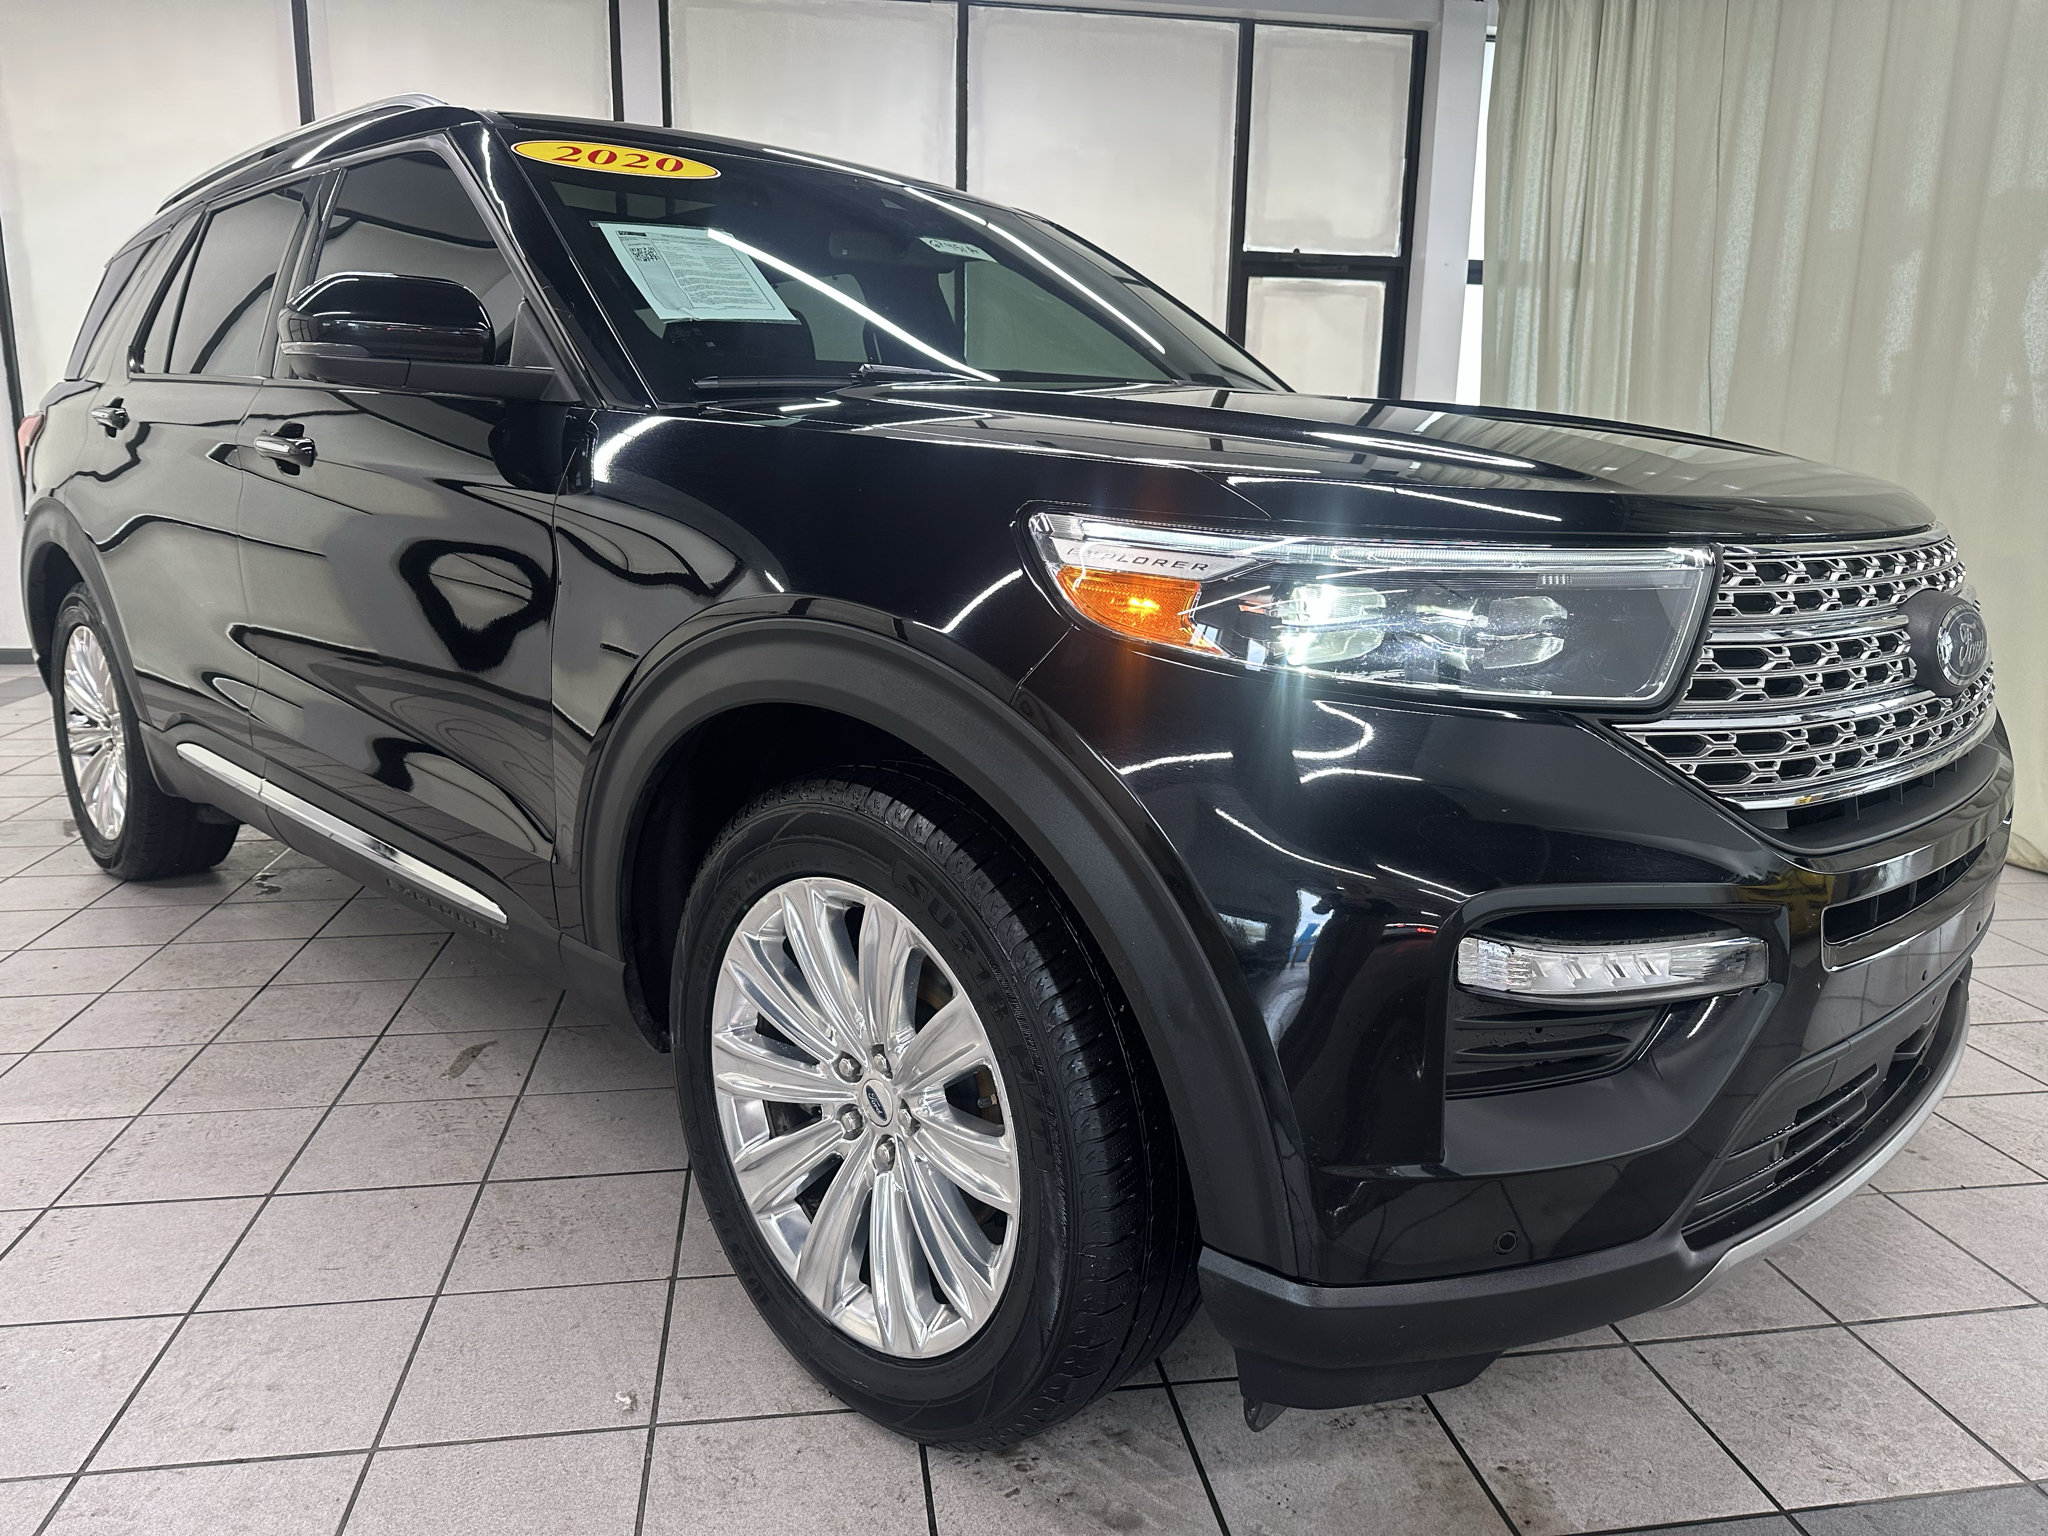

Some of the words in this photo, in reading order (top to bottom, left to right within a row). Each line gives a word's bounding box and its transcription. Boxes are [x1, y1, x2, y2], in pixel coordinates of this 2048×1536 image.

[551, 146, 684, 172] 2020
[1959, 622, 1985, 668] Ford
[868, 1092, 883, 1114] Ford
